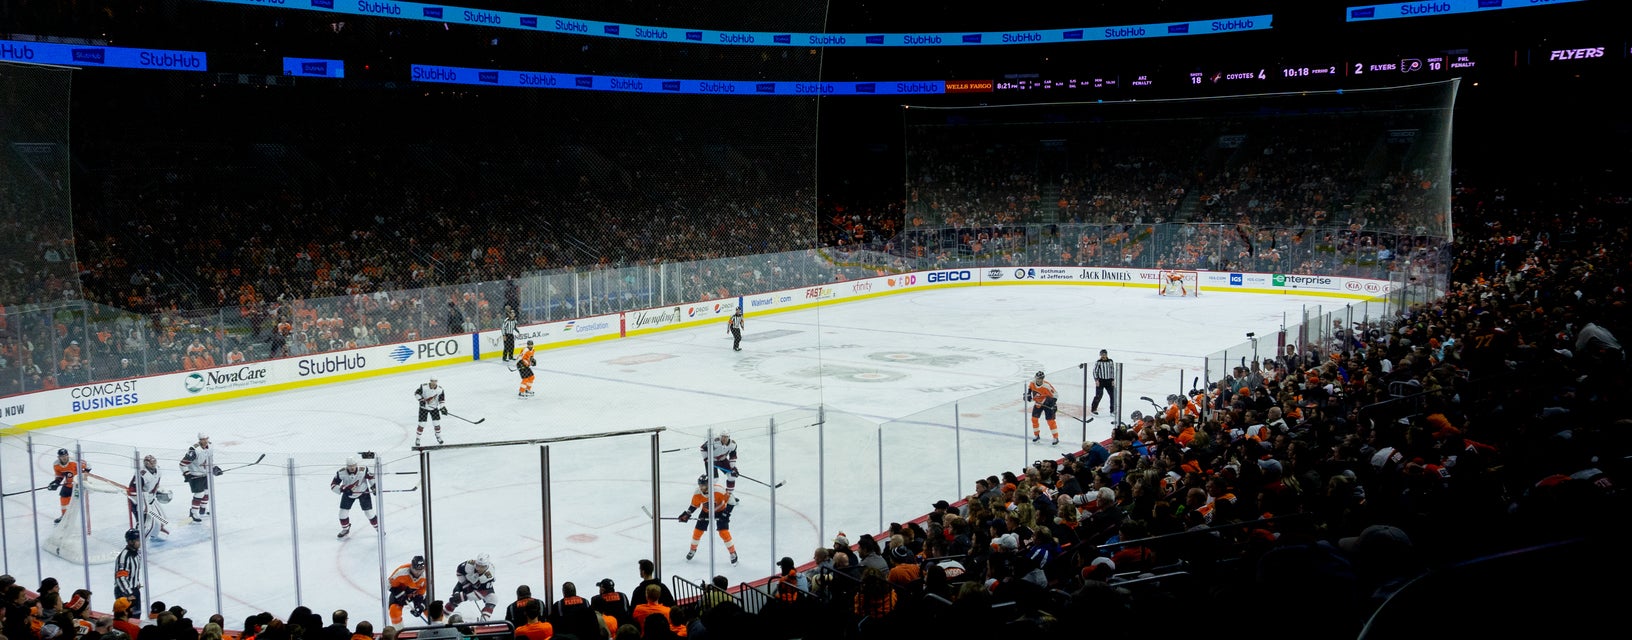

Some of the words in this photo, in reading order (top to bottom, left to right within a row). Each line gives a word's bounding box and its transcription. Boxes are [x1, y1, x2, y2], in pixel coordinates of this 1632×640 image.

[358, 1, 401, 15] StubHub
[1400, 2, 1451, 15] StubHub
[464, 11, 501, 24] StubHub
[555, 20, 588, 33] StubHub
[1211, 19, 1254, 31] StubHub
[635, 27, 668, 39] StubHub
[719, 33, 755, 43] StubHub
[1002, 32, 1042, 43] StubHub
[1105, 27, 1145, 38] StubHub
[809, 36, 846, 45] StubHub
[903, 35, 942, 44] StubHub
[0, 43, 34, 60] Hub
[1549, 46, 1605, 61] FLYERS
[140, 52, 200, 68] StubHub
[1283, 67, 1310, 77] 10:18
[1329, 66, 1336, 74] 2
[1354, 63, 1363, 74] 2
[1370, 63, 1397, 72] FLYERS
[1429, 62, 1441, 71] 10
[413, 66, 457, 81] StubHub
[1226, 72, 1254, 80] COYOTES
[1258, 68, 1266, 80] 4
[519, 74, 557, 86] StubHub
[610, 79, 643, 91] StubHub
[699, 82, 735, 93] StubHub
[795, 83, 834, 93] StubHub
[897, 84, 938, 93] StubHub
[928, 271, 971, 283] GEICO
[1080, 268, 1100, 280] JACK
[1101, 269, 1132, 281] DANIEL'S
[1276, 275, 1331, 285] enterprise
[805, 287, 823, 299] FAST
[853, 281, 872, 294] xfinity
[751, 297, 773, 307] Walmart
[632, 310, 674, 328] Yuengling
[576, 322, 609, 333] Constellation
[418, 339, 459, 359] PECO
[298, 353, 366, 376] StubHub
[206, 366, 267, 386] NovaCare
[71, 380, 137, 399] COMCAST
[72, 393, 139, 412] BUSINESS
[5, 404, 25, 417] NOW
